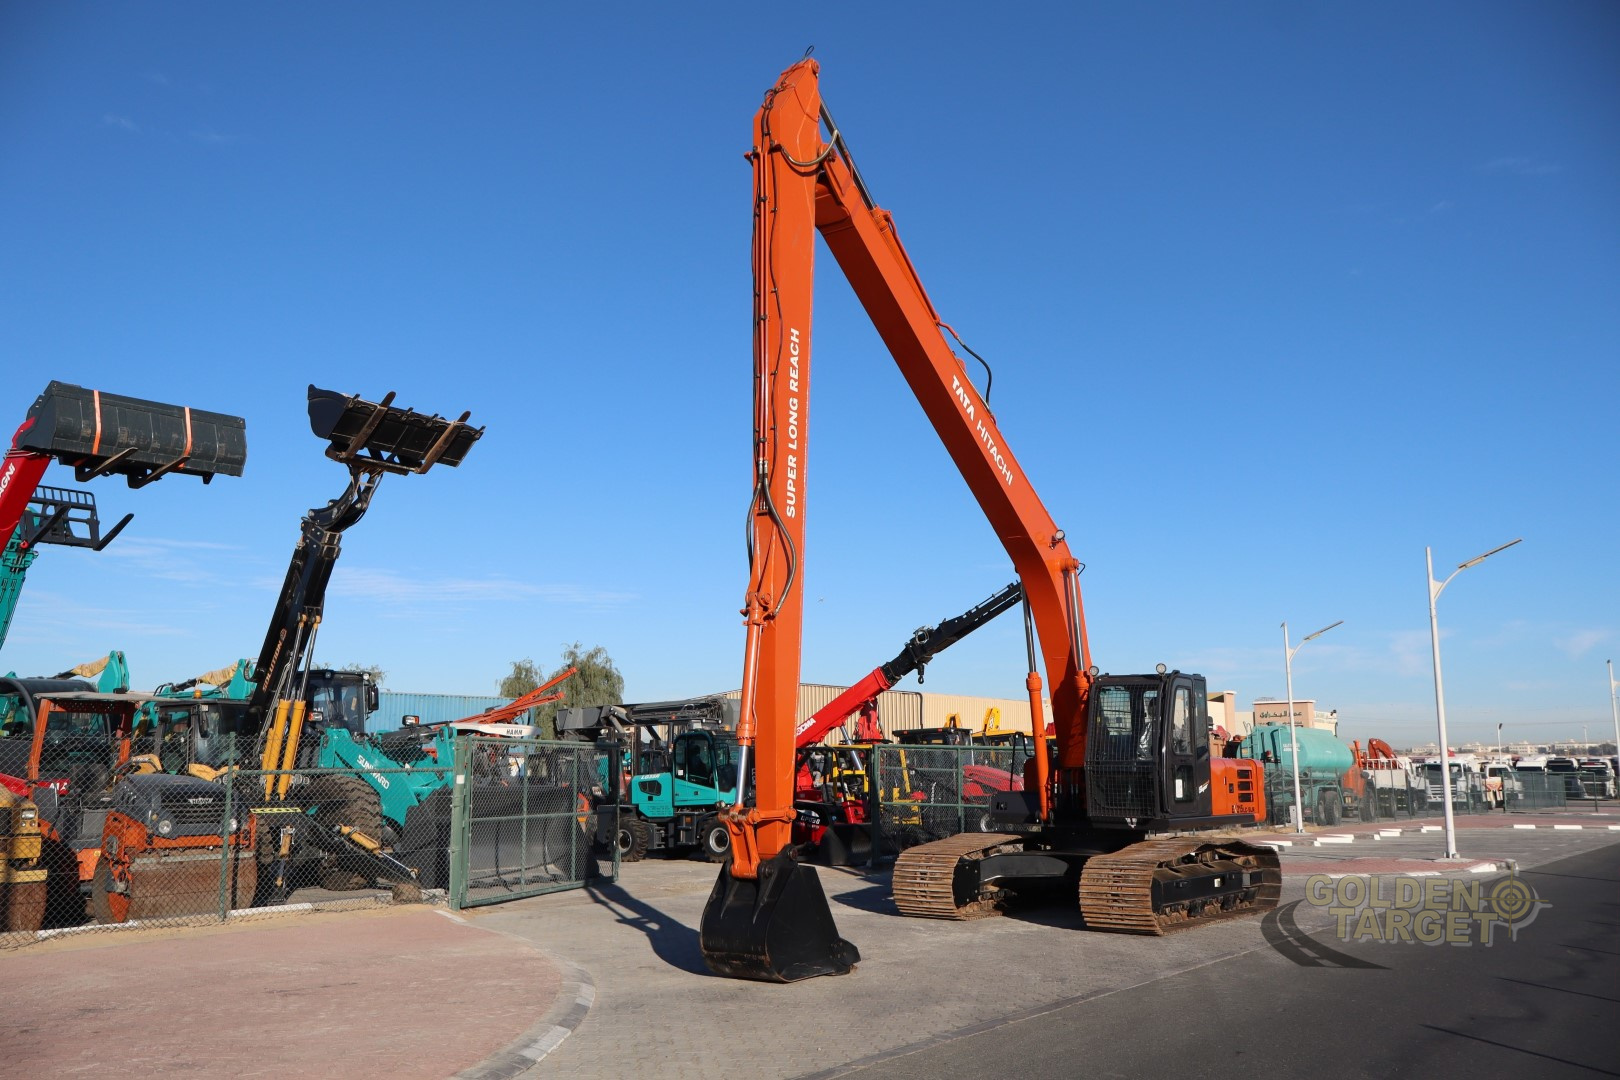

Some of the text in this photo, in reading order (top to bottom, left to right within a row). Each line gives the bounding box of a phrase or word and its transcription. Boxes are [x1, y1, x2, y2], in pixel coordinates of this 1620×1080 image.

[786, 327, 800, 518] SUPER LONG REACH
[952, 374, 1014, 486] TATA HITACHI
[506, 728, 523, 736] HAMM
